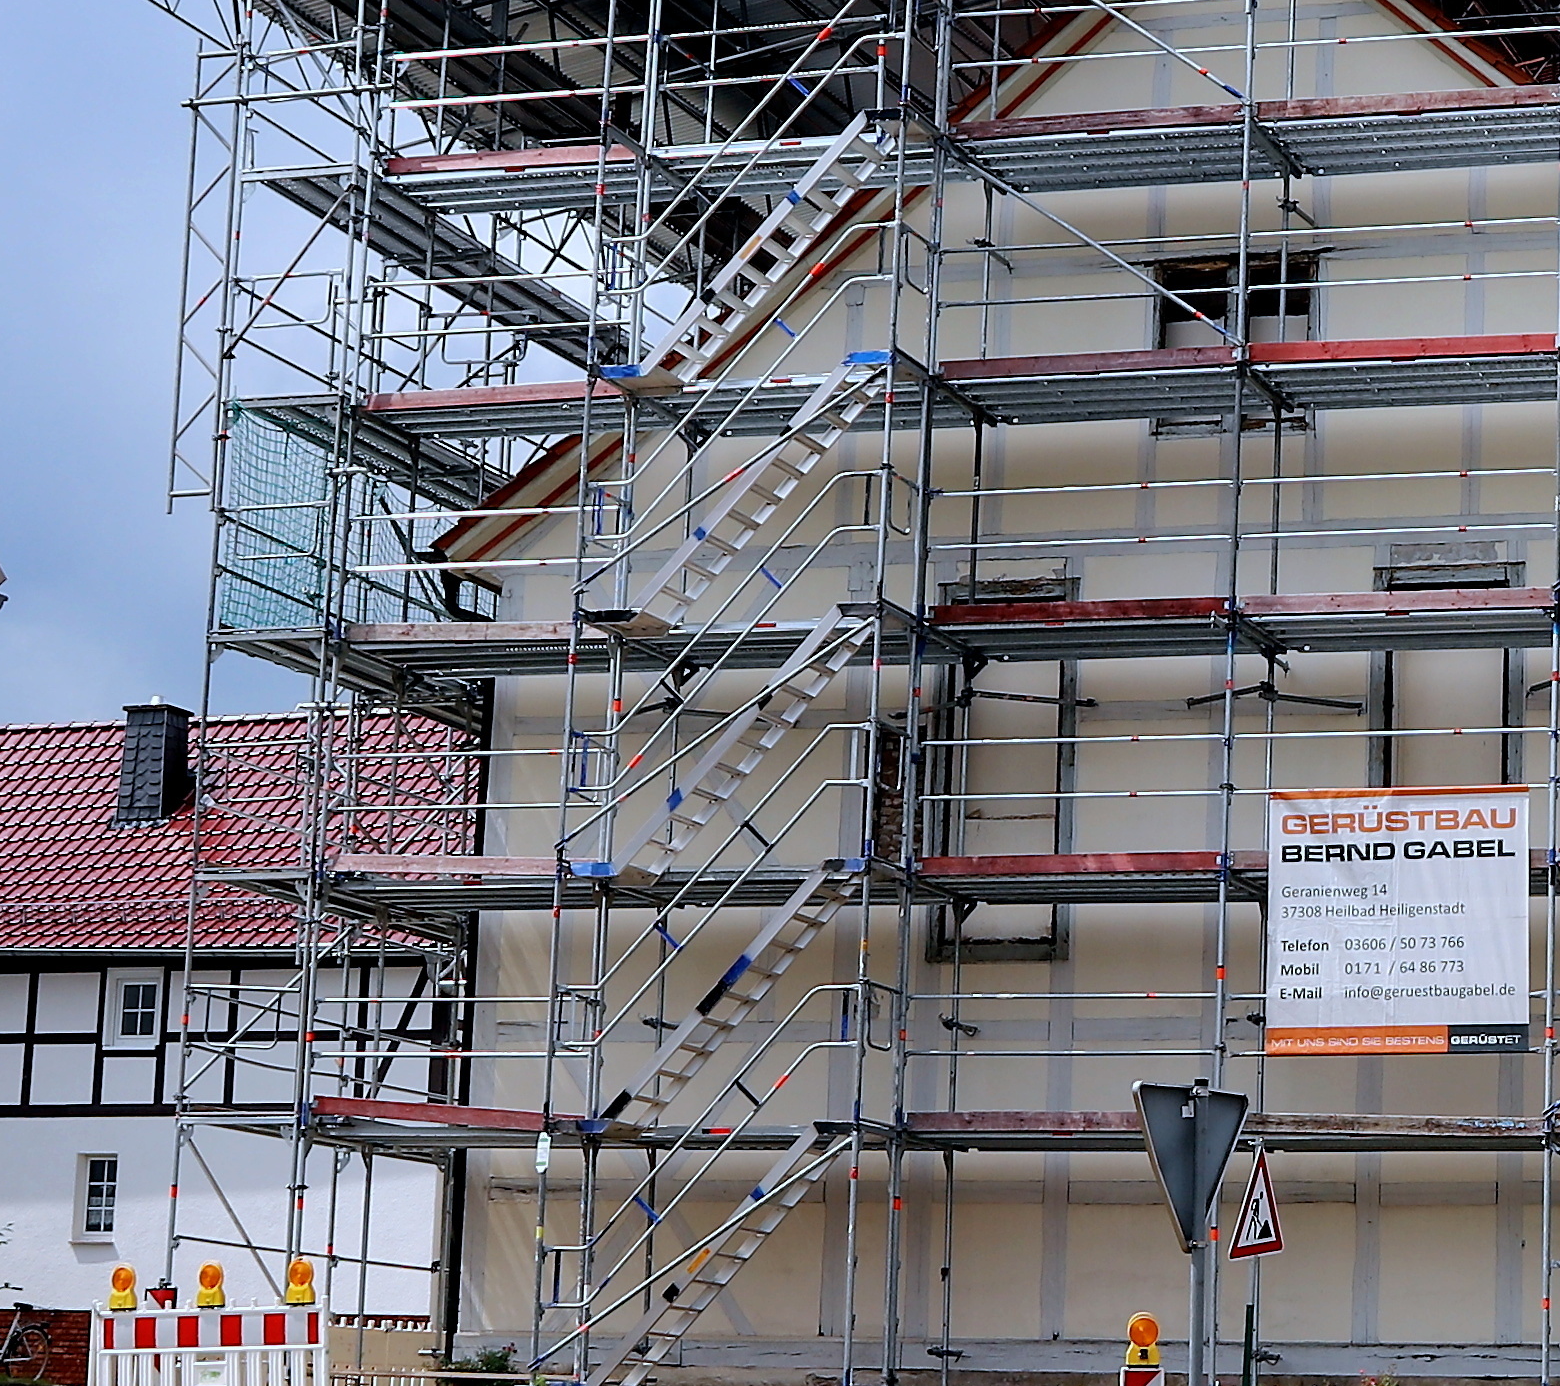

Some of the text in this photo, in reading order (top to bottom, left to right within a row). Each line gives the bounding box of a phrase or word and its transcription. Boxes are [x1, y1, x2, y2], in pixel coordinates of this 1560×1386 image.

[1281, 805, 1517, 835] GERÜSTBAU
[1281, 839, 1516, 863] BERND GABEL
[1281, 884, 1388, 899] Geranienweg 14
[1281, 902, 1466, 919] 37308 Heilbad Heiligenstadt
[1280, 937, 1464, 953] Telefon 03606 / 50 73 766
[1280, 963, 1320, 976] Mobil
[1344, 963, 1382, 975] 0171
[1400, 961, 1416, 973] 64
[1420, 961, 1436, 973] 86
[1440, 961, 1464, 973] 773
[1280, 983, 1516, 999] E-Mail info@geruestbaugabel.de
[1271, 1033, 1522, 1047] MIT UNS SIND SIE BESTENS GERÜSTET
